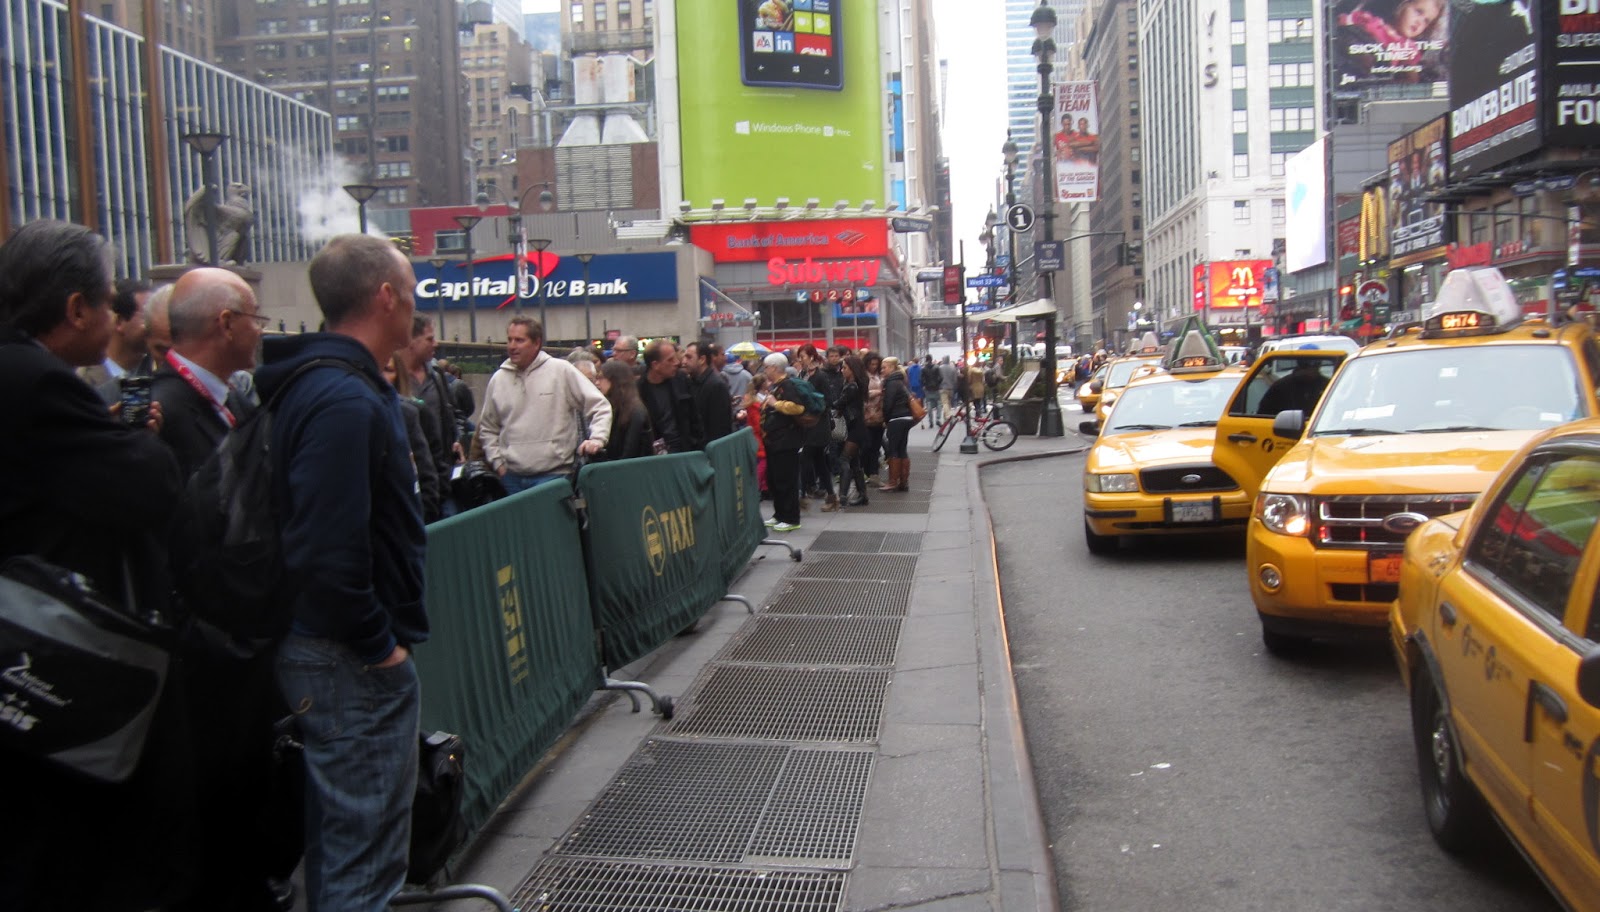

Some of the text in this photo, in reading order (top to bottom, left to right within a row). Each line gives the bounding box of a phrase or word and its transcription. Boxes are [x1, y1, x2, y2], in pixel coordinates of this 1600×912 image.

[1349, 40, 1444, 54] SICK ALL THE
[1375, 50, 1417, 62] TIME?
[1060, 84, 1091, 93] WE ARE
[1060, 100, 1090, 112] TEAM
[1452, 69, 1537, 139] BIOWEB ELITE
[1558, 99, 1600, 126] FO
[753, 122, 793, 133] Windows
[795, 124, 821, 135] Phone
[727, 231, 829, 249] Bank of America
[767, 256, 881, 286] Subway
[416, 275, 516, 301] Capital
[569, 278, 629, 297] Bank
[1442, 313, 1478, 328] 6H74
[660, 505, 695, 553] TAXI
